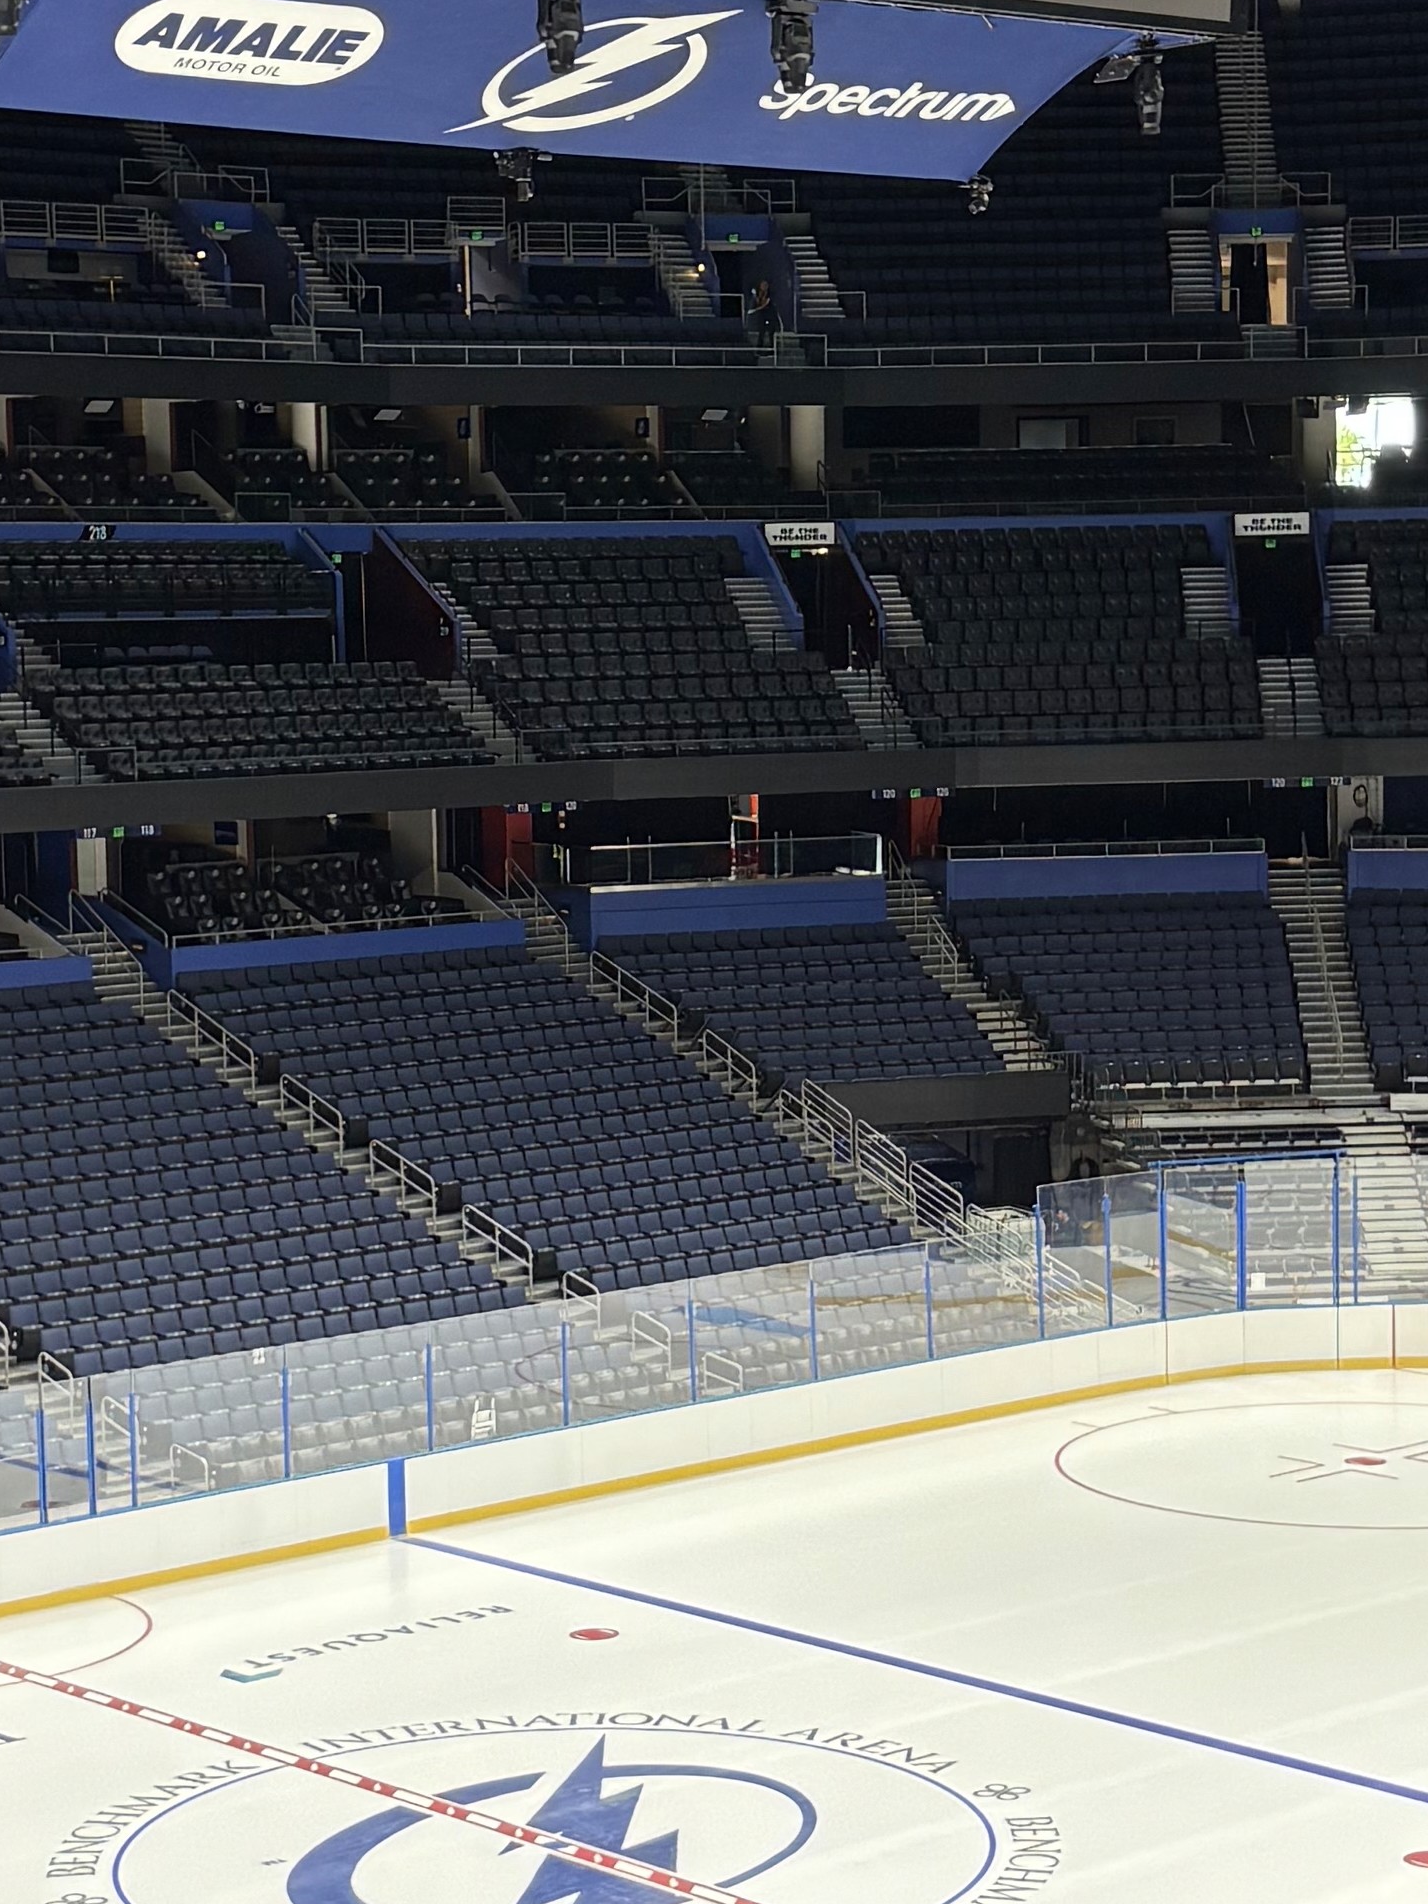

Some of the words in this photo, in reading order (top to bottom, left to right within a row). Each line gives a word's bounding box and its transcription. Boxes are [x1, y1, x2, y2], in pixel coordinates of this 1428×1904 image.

[132, 12, 371, 65] AMALIE
[173, 56, 246, 76] MOTOR
[251, 63, 282, 78] OIL
[759, 73, 1015, 121] Spectrum
[83, 827, 97, 838] 117
[243, 1604, 515, 1669] RELIAQUEST
[46, 1759, 262, 1880] BENCHMARK
[299, 1712, 768, 1755] INTERNATIONAL
[778, 1727, 961, 1776] ARENA
